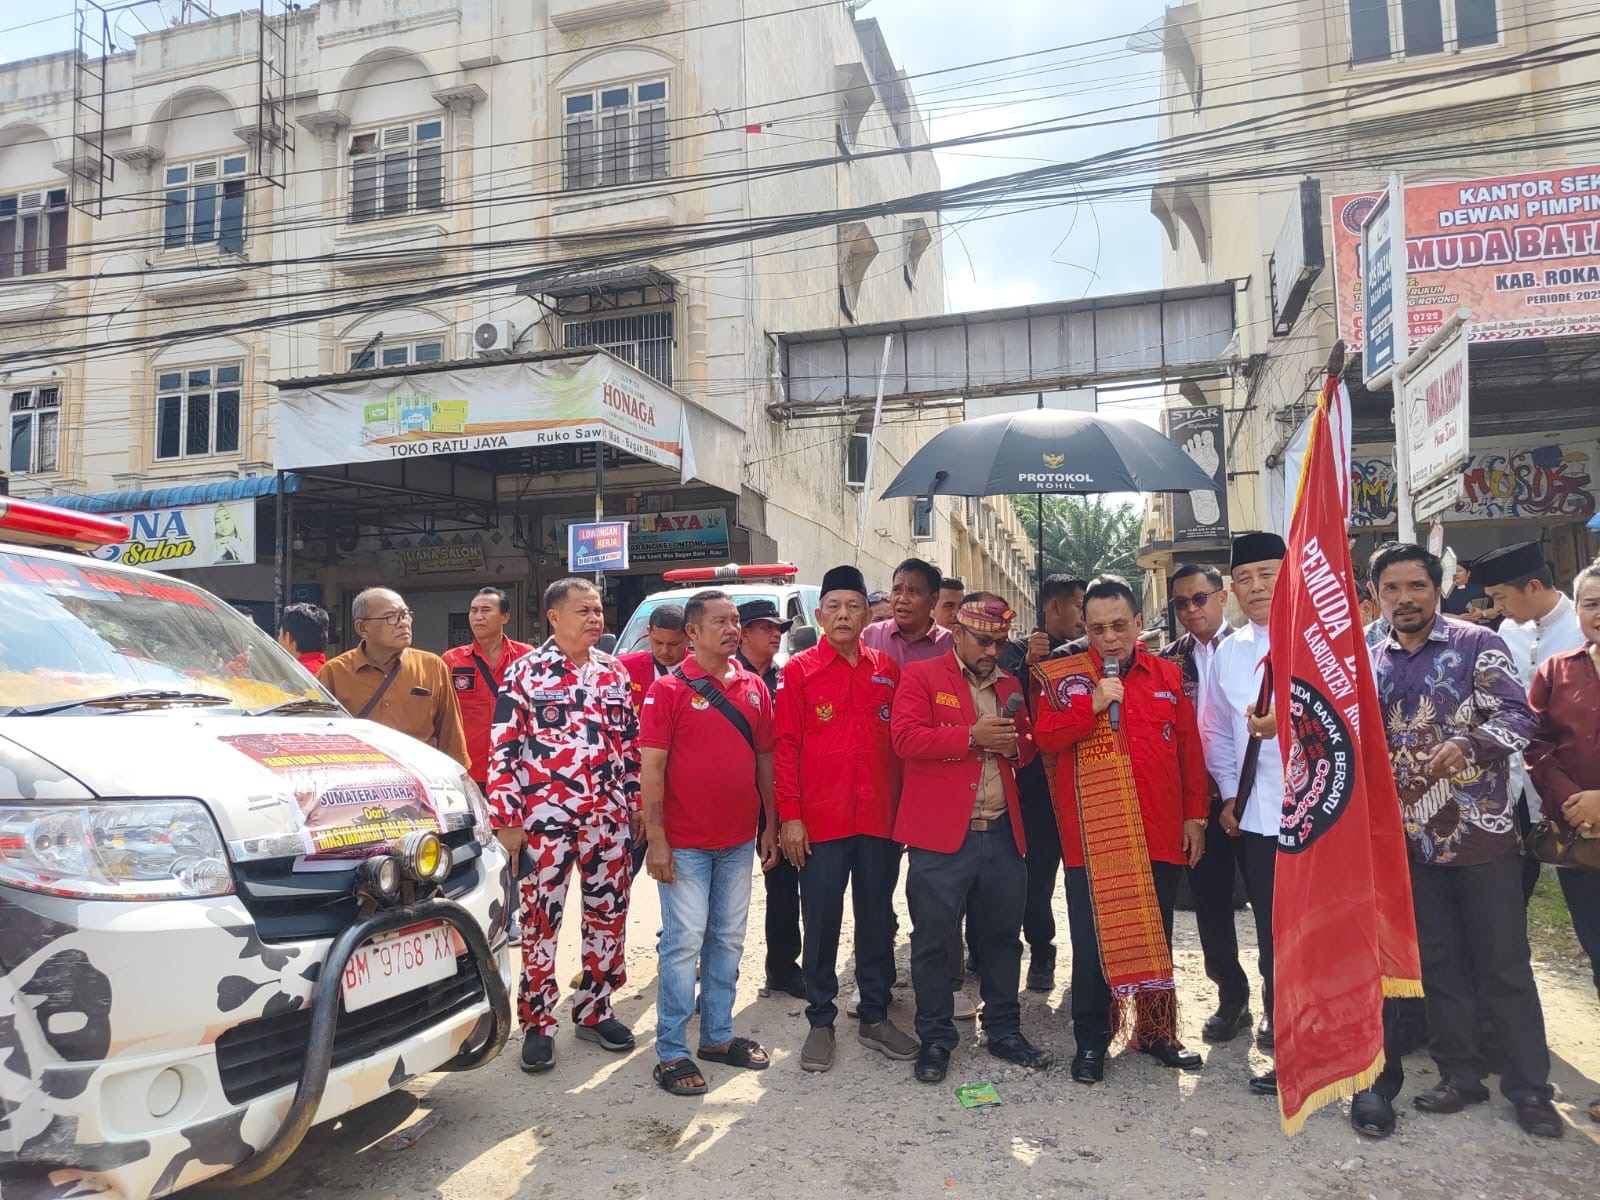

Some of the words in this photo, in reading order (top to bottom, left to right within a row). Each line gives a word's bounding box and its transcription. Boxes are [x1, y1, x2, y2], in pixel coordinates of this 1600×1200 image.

[1460, 180, 1555, 205] KANTOR
[1439, 203, 1519, 227] DEWAN
[1406, 230, 1511, 271] MUDA
[1515, 220, 1600, 260] BAT
[1495, 271, 1541, 290] KAB.
[1410, 286, 1445, 296] RUKUN
[1418, 295, 1458, 305] ROYONG
[1527, 292, 1572, 304] PERIODE
[1413, 312, 1439, 321] 0722
[602, 382, 656, 427] HONAGA
[1171, 408, 1219, 420] STAR
[389, 443, 428, 457] TOKO
[432, 439, 469, 454] RATU
[473, 435, 508, 450] JAYA
[537, 431, 570, 443] Ruko
[1018, 473, 1094, 482] PROTOKOL
[582, 527, 618, 539] LOWONGAN
[597, 537, 617, 547] KERJA
[122, 540, 194, 566] Salon
[440, 546, 479, 559] SALON
[1301, 536, 1352, 641] PEMUDA
[1302, 622, 1355, 700] KABUPATEN
[1313, 701, 1343, 745] BATAK
[1322, 751, 1347, 815] BERSATU
[320, 788, 379, 806] SUMATERA
[381, 786, 414, 800] UTARA
[344, 951, 370, 990] BM
[380, 936, 424, 977] 9768
[432, 927, 452, 961] XX
